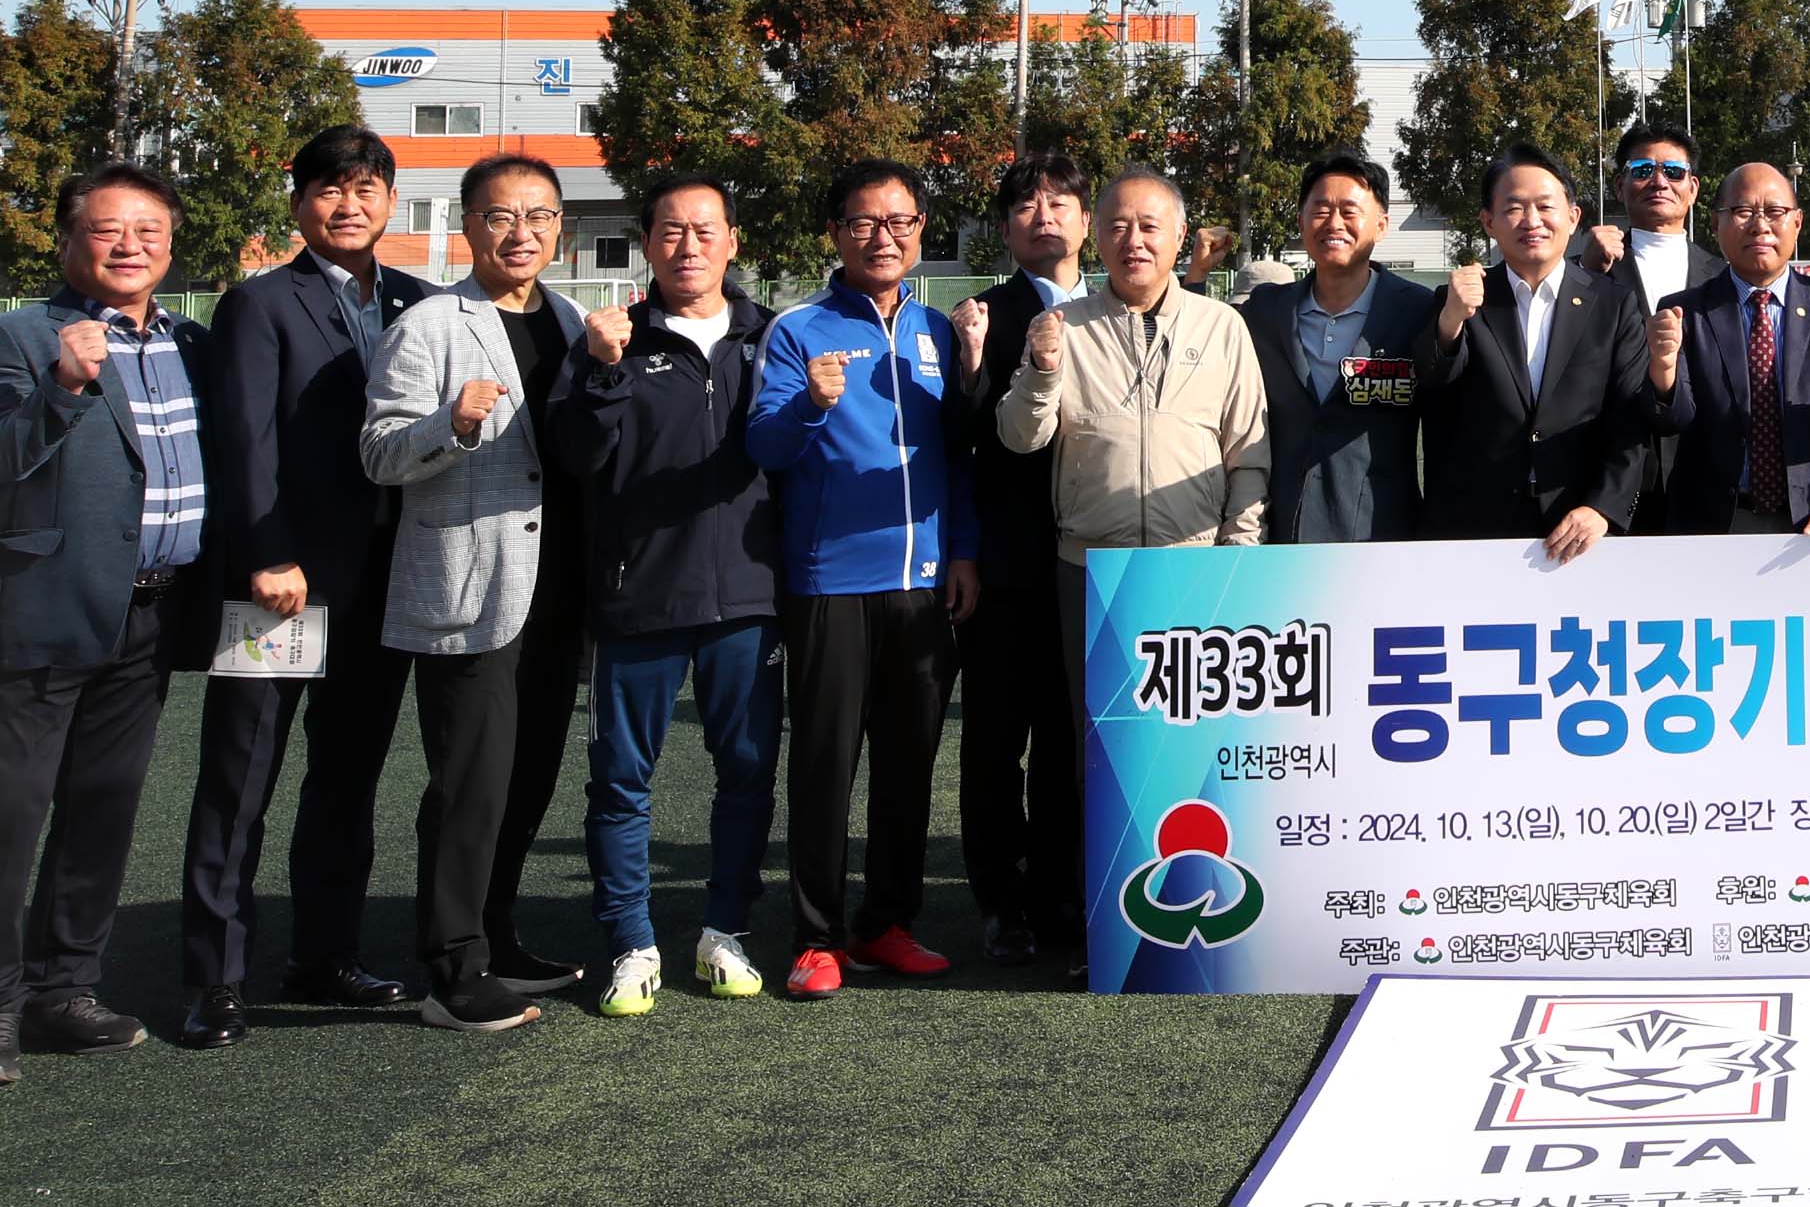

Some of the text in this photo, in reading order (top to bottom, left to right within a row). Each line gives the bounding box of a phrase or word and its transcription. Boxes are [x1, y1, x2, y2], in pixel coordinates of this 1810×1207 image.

[362, 58, 423, 75] JINWOO
[533, 57, 572, 96] 진
[1349, 377, 1412, 403] 심재돈
[920, 561, 937, 578] 38
[1136, 623, 1330, 723] 제33회
[1367, 615, 1807, 763] 동구청장기
[1217, 743, 1336, 781] 인천광역시
[1276, 813, 1331, 847] 일정
[1358, 812, 1427, 843] 2024.
[1437, 811, 1472, 841] 10.
[1576, 806, 1610, 836] 10.
[1704, 798, 1776, 833] 2일간
[1325, 877, 1678, 919] 주최: 인천광역시동구체육회
[1716, 875, 1777, 905] 후원:
[1339, 926, 1694, 967] 주관: 인천광역시동구체육회
[1713, 954, 1731, 962] IDFA
[1480, 1137, 1757, 1175] IDFA
